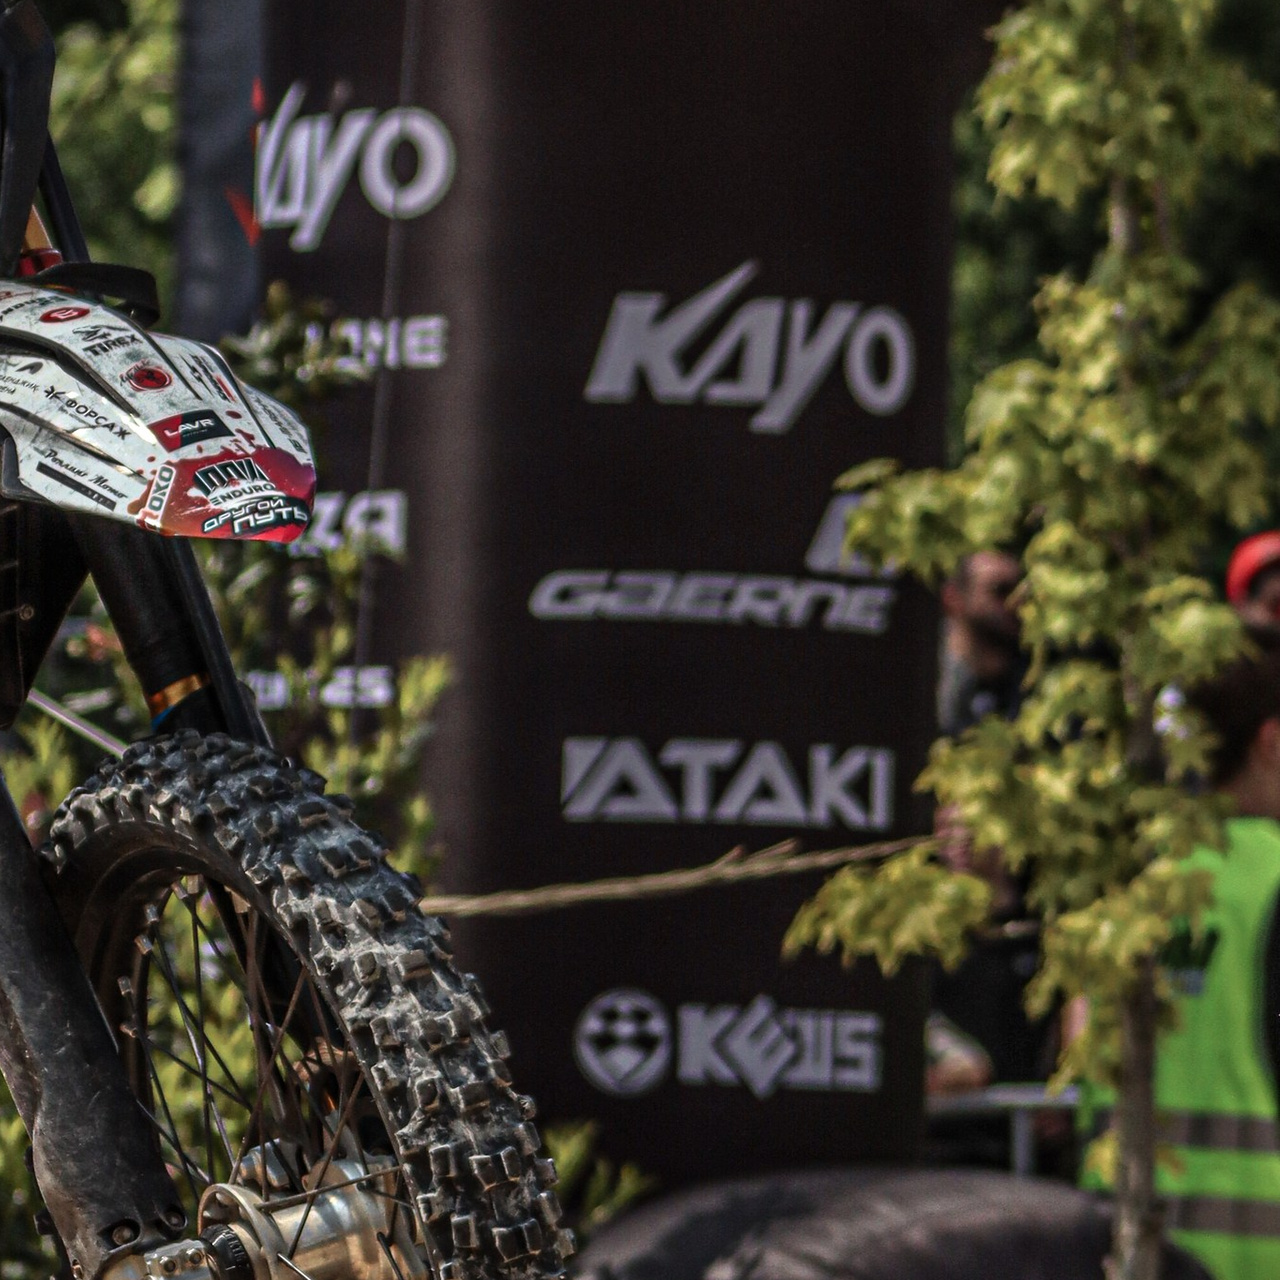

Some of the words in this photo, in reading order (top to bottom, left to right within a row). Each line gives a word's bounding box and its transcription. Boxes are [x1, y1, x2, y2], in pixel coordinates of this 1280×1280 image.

[583, 258, 914, 435] KAYO
[65, 398, 132, 440] ФОРСАЖ
[163, 417, 215, 437] LAVR
[210, 483, 276, 506] ENDURO
[203, 496, 285, 533] ДРУГОЙ
[233, 506, 309, 534] ПУТЬ
[561, 735, 896, 832] ATAKI
